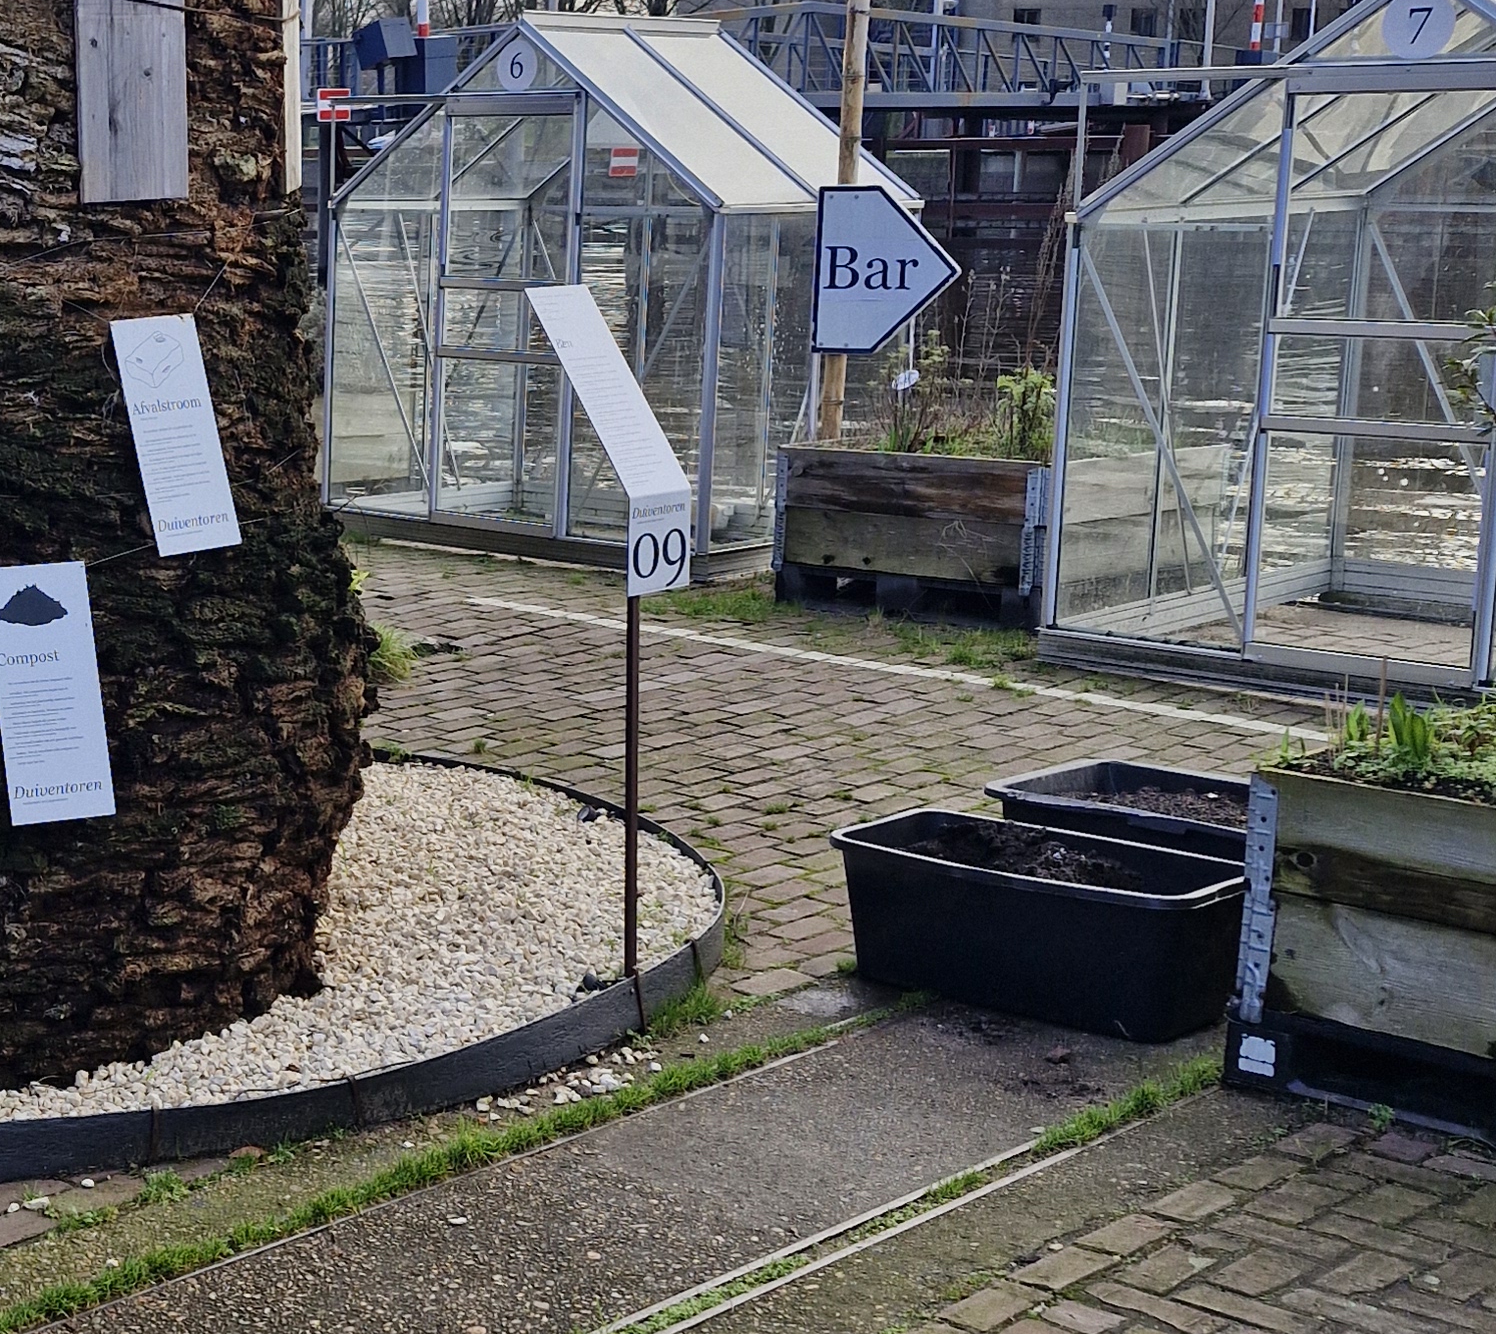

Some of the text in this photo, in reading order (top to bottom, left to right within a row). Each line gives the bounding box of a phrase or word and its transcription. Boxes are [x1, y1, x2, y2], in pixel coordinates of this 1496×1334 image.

[1409, 7, 1433, 44] 7
[510, 51, 523, 79] 6
[823, 245, 919, 290] Bar
[132, 396, 202, 416] Afvalstroom
[157, 510, 230, 533] Duiventoren
[632, 503, 686, 519] Duiventoren
[632, 528, 686, 587] 09
[13, 780, 102, 800] Duiventoren
